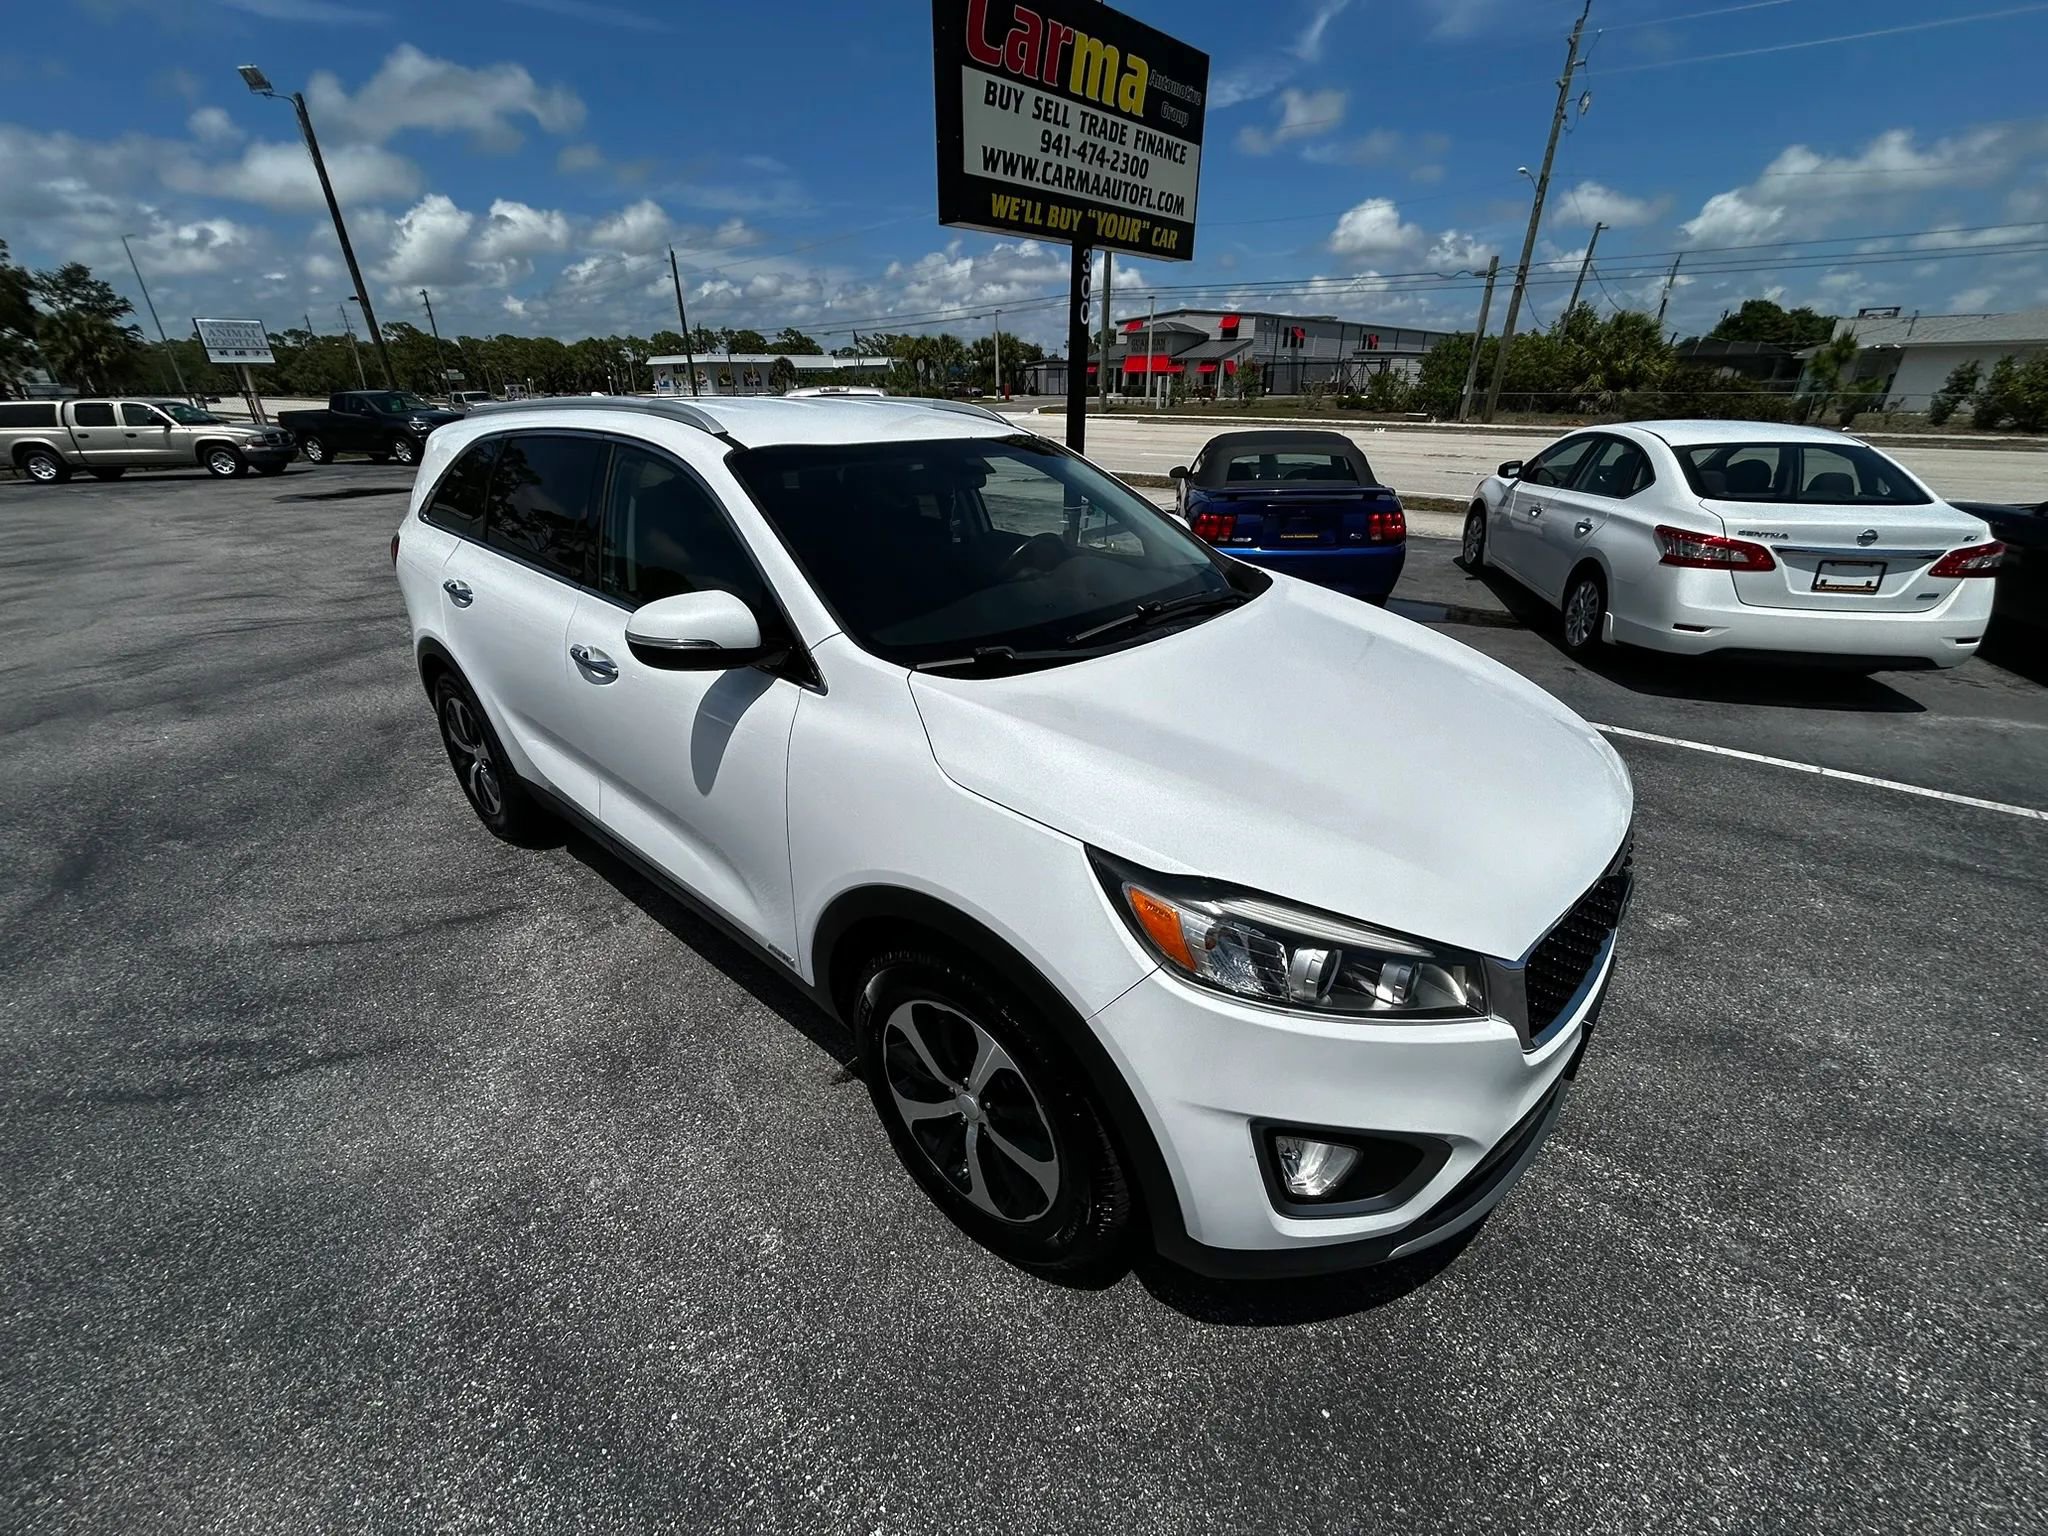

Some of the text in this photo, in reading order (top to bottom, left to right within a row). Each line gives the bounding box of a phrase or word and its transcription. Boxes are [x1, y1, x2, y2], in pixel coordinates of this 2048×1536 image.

[966, 0, 1149, 117] Carma
[1148, 69, 1202, 105] Automotive
[984, 79, 1188, 165] BUY SELL TRADE FINANCE
[1160, 101, 1189, 128] Group
[1040, 129, 1149, 180] 941-474-2300
[981, 145, 1185, 216] WWW.CARMAAUTOFL.COM
[991, 193, 1043, 226] WE'LL
[1047, 205, 1083, 231] BUY
[1151, 226, 1178, 249] CAR
[204, 337, 266, 347] HOSPITAL
[208, 328, 260, 338] ANIMAL
